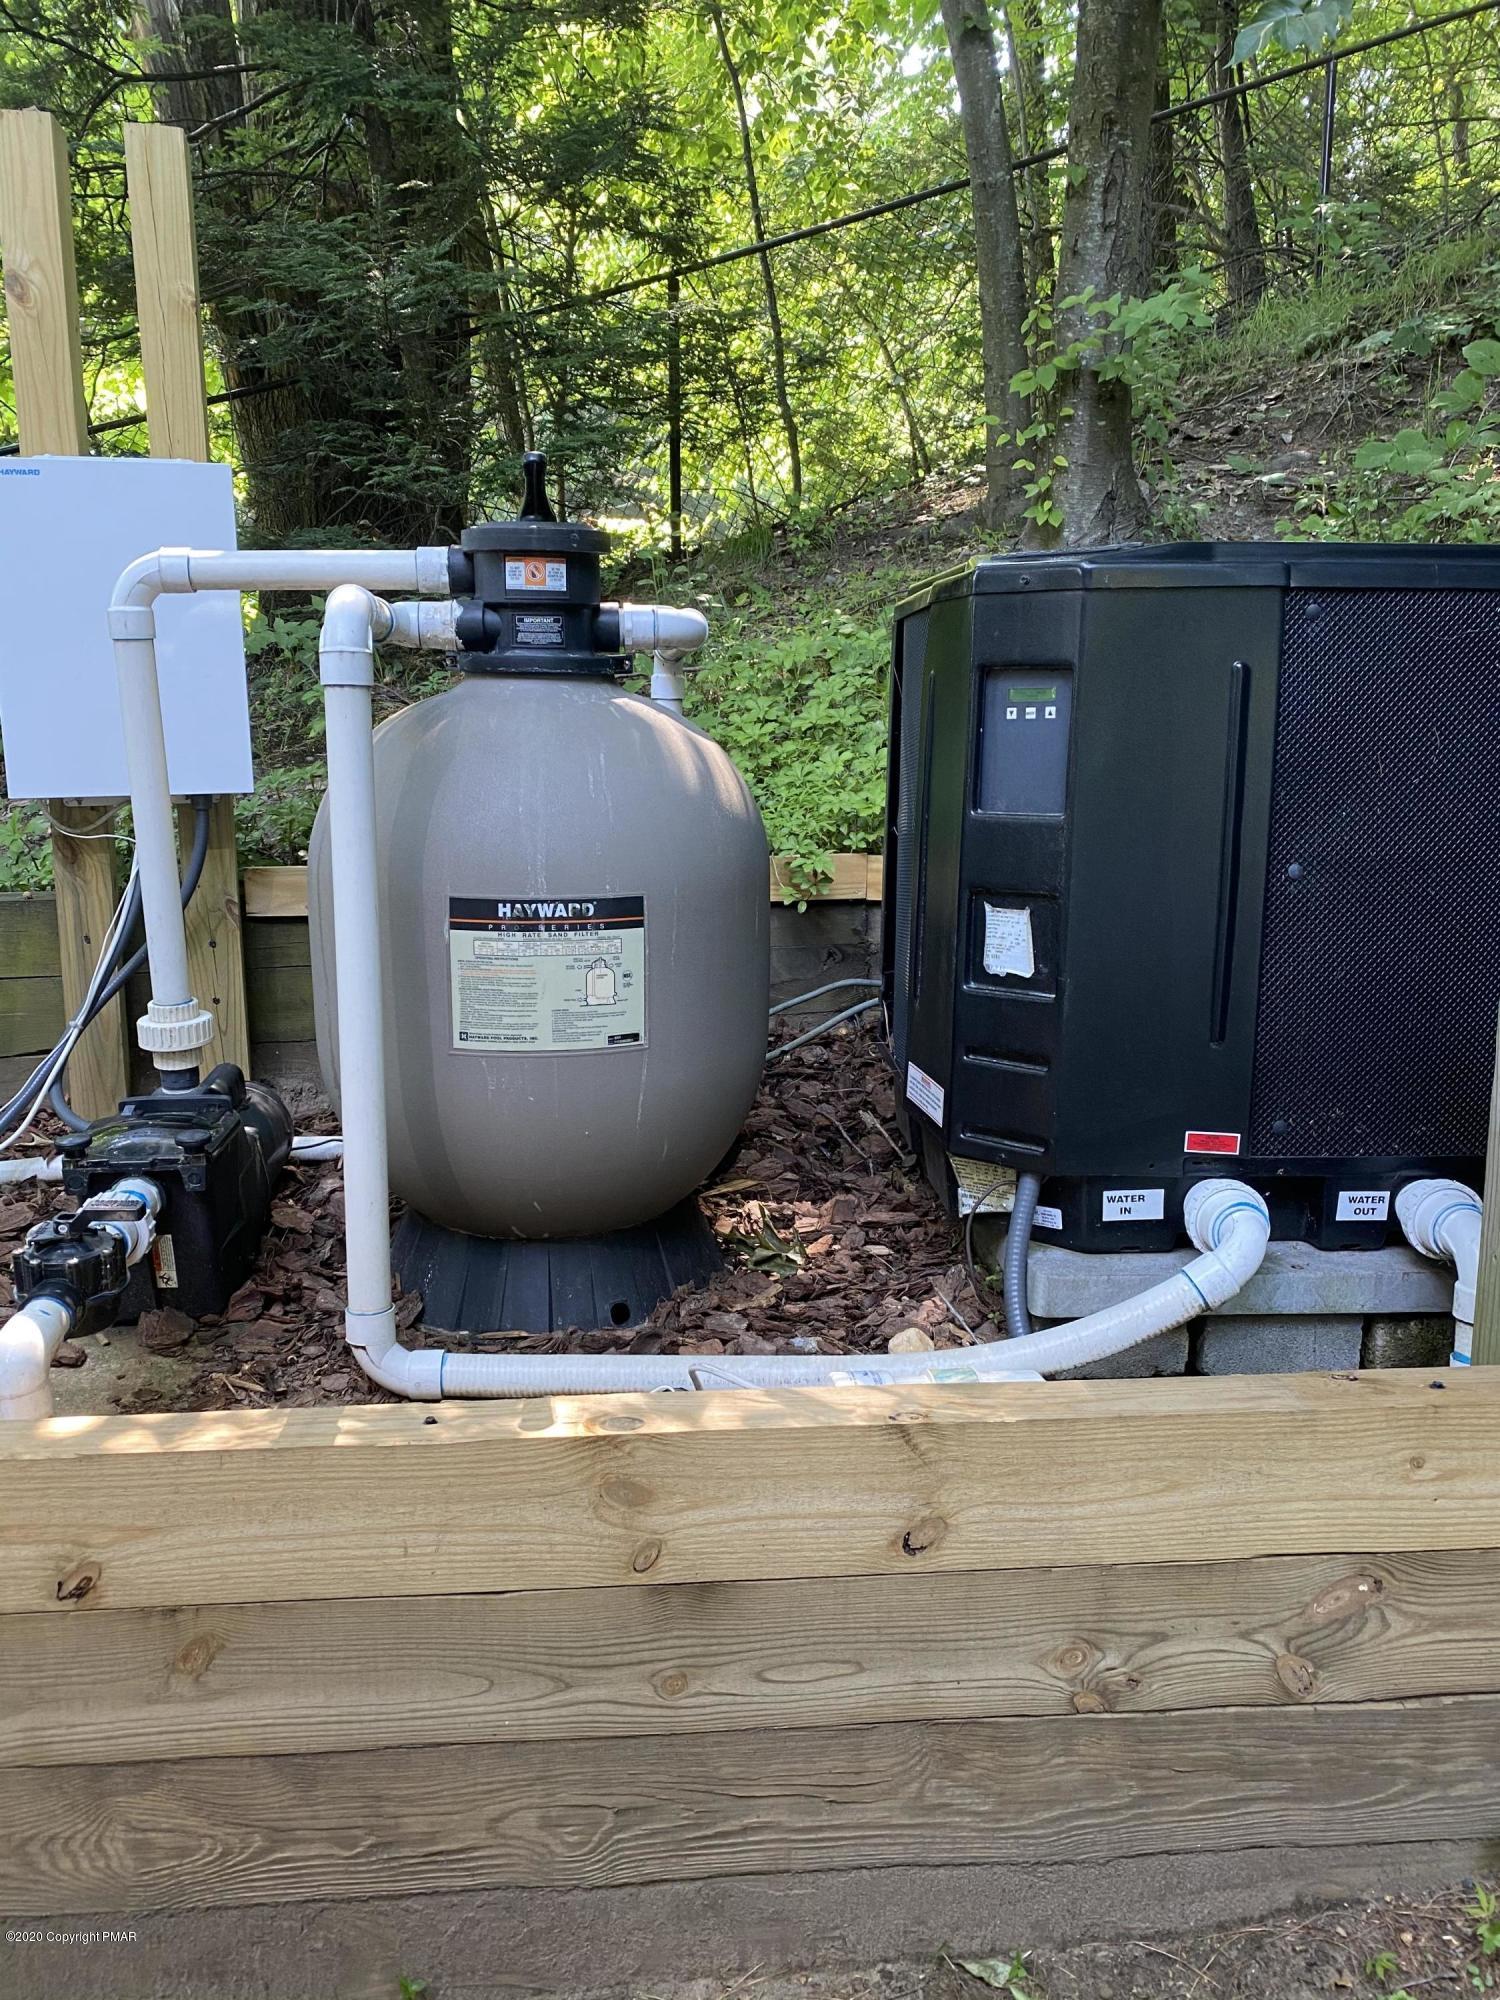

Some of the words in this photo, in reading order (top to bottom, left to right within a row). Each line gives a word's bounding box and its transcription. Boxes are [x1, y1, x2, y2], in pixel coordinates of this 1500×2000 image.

[497, 902, 595, 918] HAYWARD
[538, 923, 605, 931] SERIES
[1106, 1194, 1146, 1204] WATER
[1348, 1195, 1386, 1205] WATER
[1119, 1207, 1132, 1216] IN
[1353, 1207, 1378, 1216] OUT
